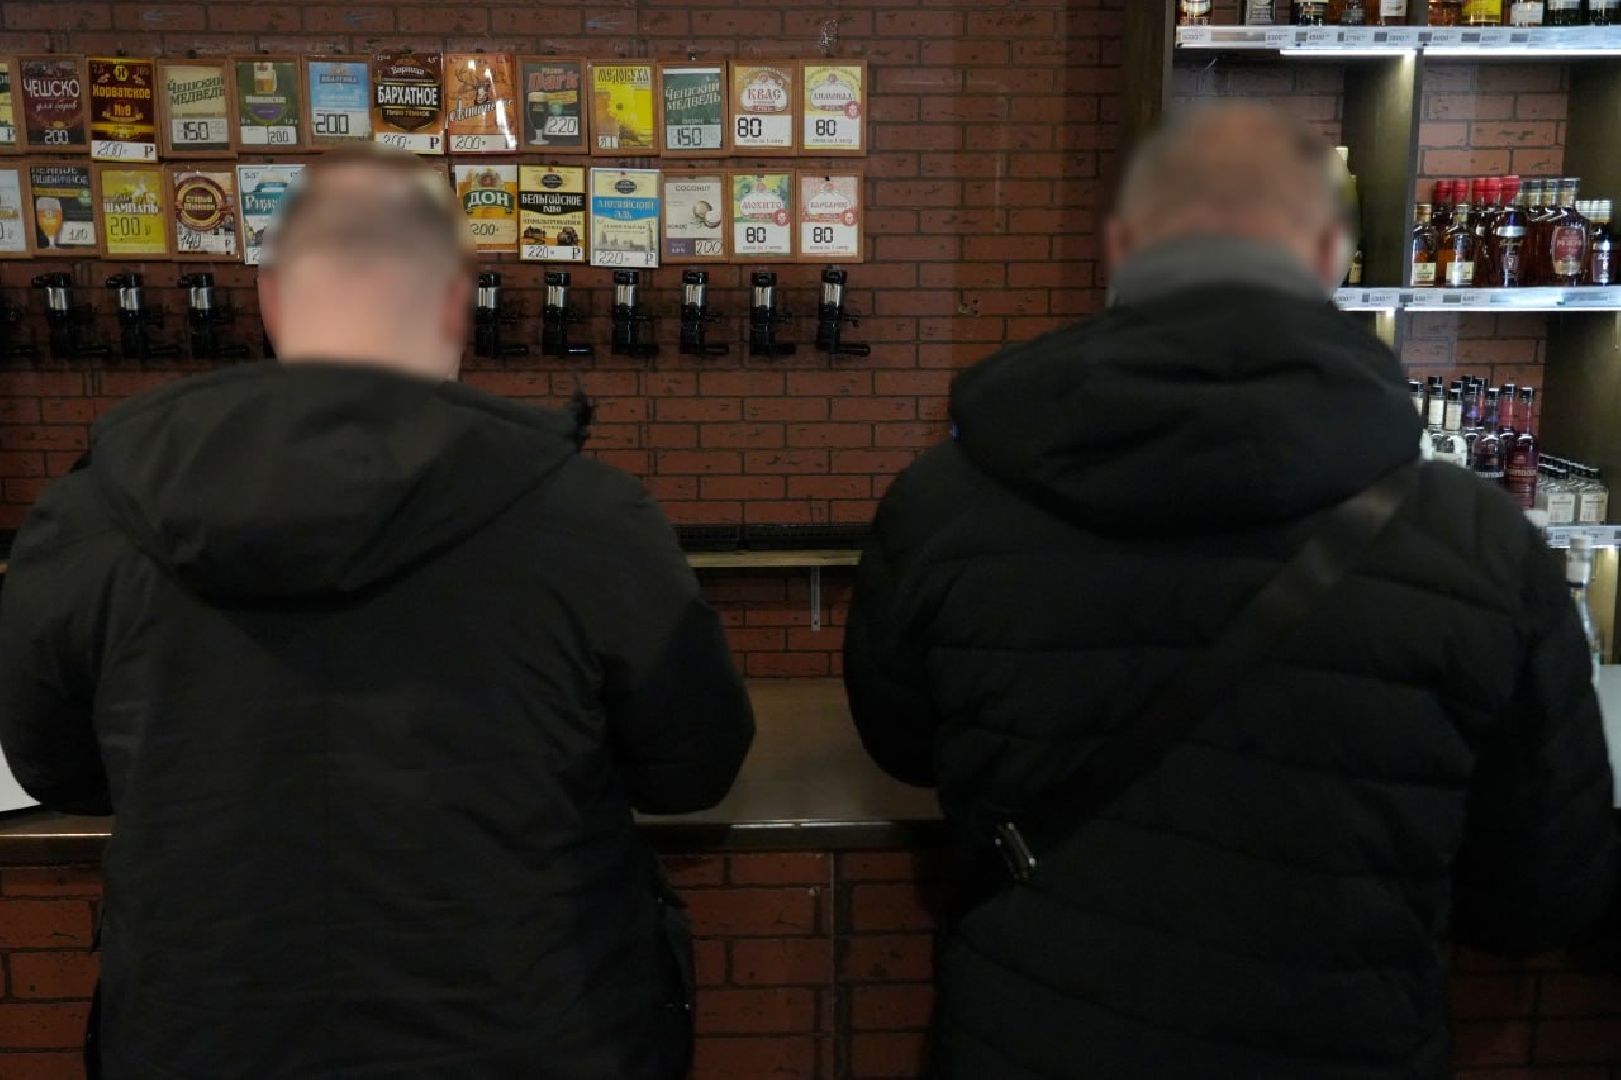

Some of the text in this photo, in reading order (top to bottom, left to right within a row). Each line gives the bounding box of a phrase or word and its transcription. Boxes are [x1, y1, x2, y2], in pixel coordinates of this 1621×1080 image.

[377, 86, 439, 106] БАРХАТНОЕ
[748, 88, 781, 100] КВАС
[183, 121, 209, 140] 150
[316, 113, 350, 135] 200
[547, 118, 577, 133] 220
[737, 117, 762, 138] 80
[815, 119, 837, 136] 80
[45, 129, 69, 145] 200
[270, 131, 289, 142] 200
[677, 127, 702, 146] 150
[675, 184, 710, 192] COCONUT
[467, 191, 508, 208] ДОН
[110, 217, 140, 236] 200
[746, 226, 767, 243] 80
[813, 226, 834, 243] 80
